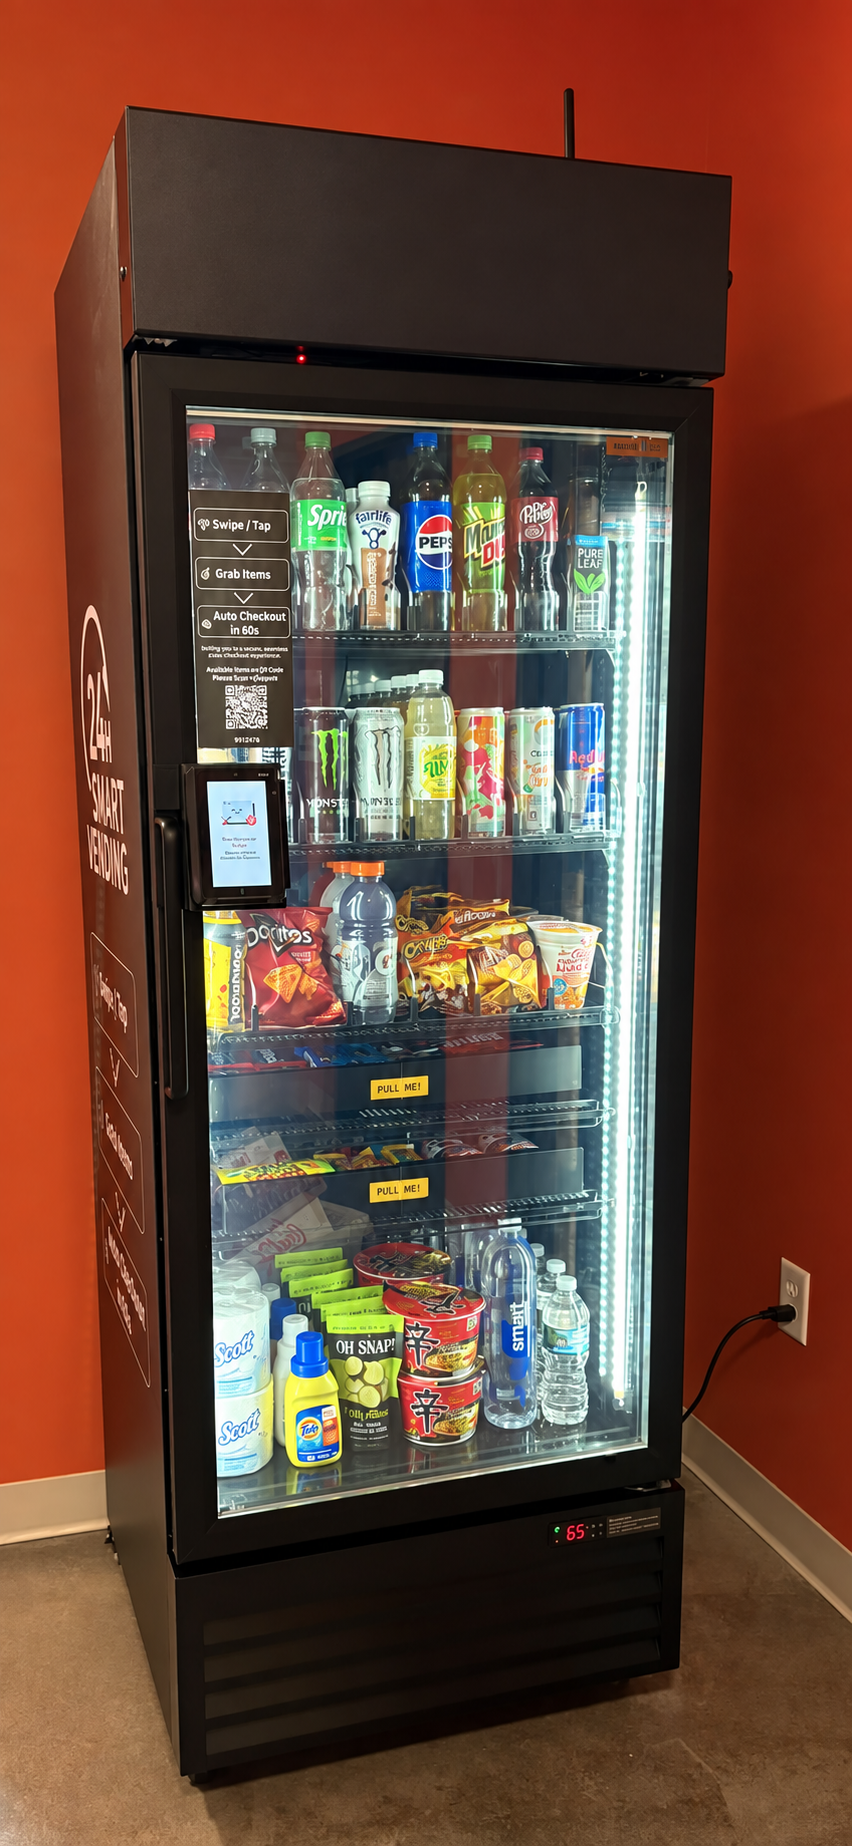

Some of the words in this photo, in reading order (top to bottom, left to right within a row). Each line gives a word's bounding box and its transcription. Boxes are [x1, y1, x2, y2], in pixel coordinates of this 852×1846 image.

[212, 519, 244, 532] Swipe
[246, 519, 251, 532] /
[252, 520, 271, 533] Tap
[355, 510, 392, 526] fairlife
[577, 547, 604, 559] PURE
[577, 558, 603, 569] LEAF
[215, 568, 241, 579] Grab
[242, 569, 271, 580] Items
[213, 611, 237, 621] Auto
[239, 611, 286, 621] Checkout
[230, 624, 240, 635] in
[241, 625, 259, 635] 60s
[91, 772, 125, 835] SMART
[86, 824, 129, 896] VENDING
[247, 924, 313, 948] Doritos
[377, 1084, 399, 1094] PULL
[404, 1082, 421, 1092] ME!
[377, 1186, 399, 1196] PULL
[403, 1184, 420, 1194] ME!
[509, 1301, 526, 1352] smart
[214, 1330, 255, 1368] Scott
[335, 1339, 355, 1355] OH
[358, 1337, 396, 1355] SNAP!
[404, 1320, 441, 1369] 辛
[410, 1387, 450, 1435] 辛
[218, 1408, 261, 1446] Scott
[566, 1523, 585, 1541] 65
